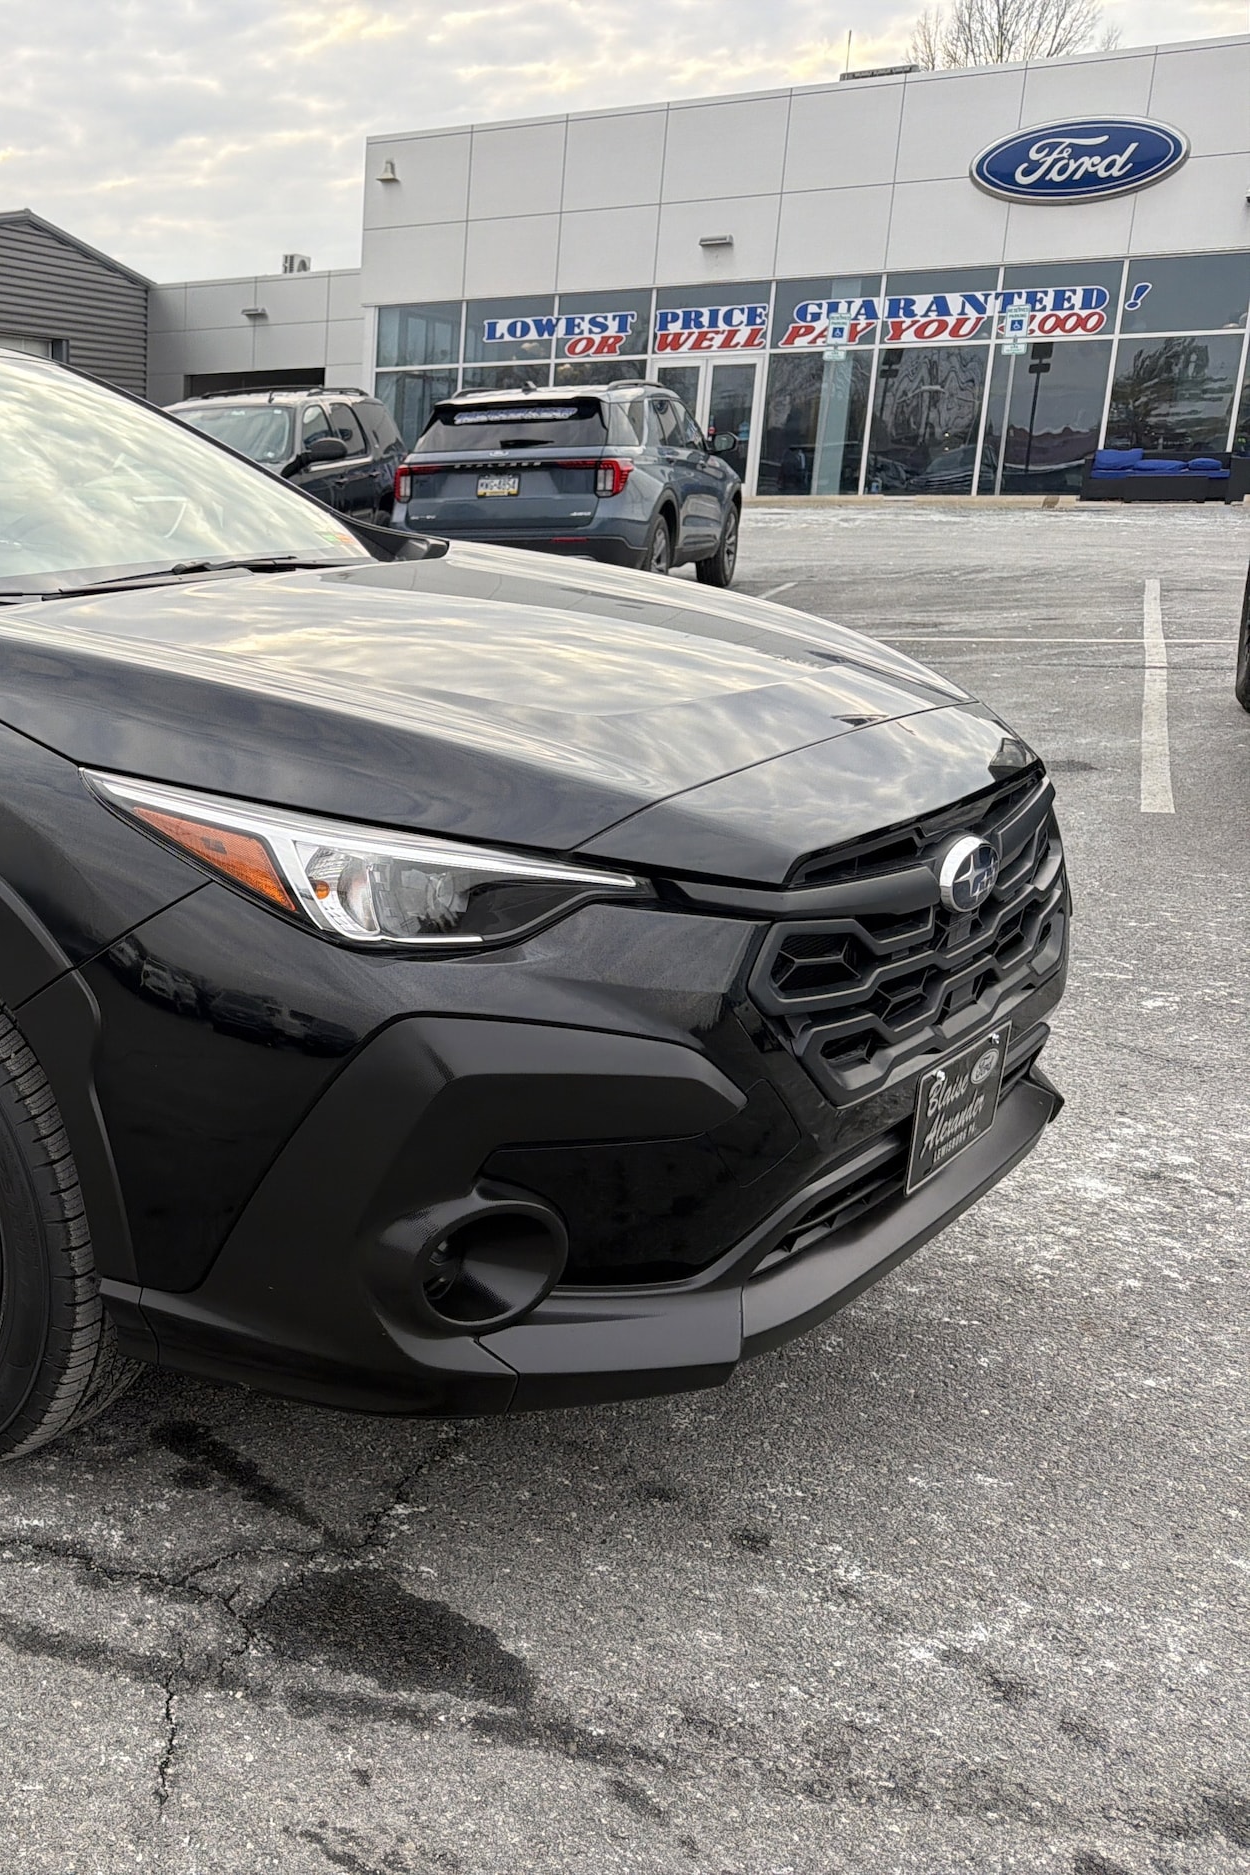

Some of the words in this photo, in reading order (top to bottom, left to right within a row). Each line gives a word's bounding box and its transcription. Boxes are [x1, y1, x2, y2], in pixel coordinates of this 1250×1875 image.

[1014, 135, 1139, 185] Ford
[485, 313, 636, 341] LOWEST
[656, 305, 767, 331] PRICE
[794, 287, 1109, 323] GUARANTEED
[566, 336, 625, 356] OR
[656, 327, 766, 352] WE'LL
[885, 317, 986, 341] YOU
[997, 311, 1106, 335] ,000
[927, 1073, 970, 1118] Blaise
[920, 1089, 985, 1160] Alexander
